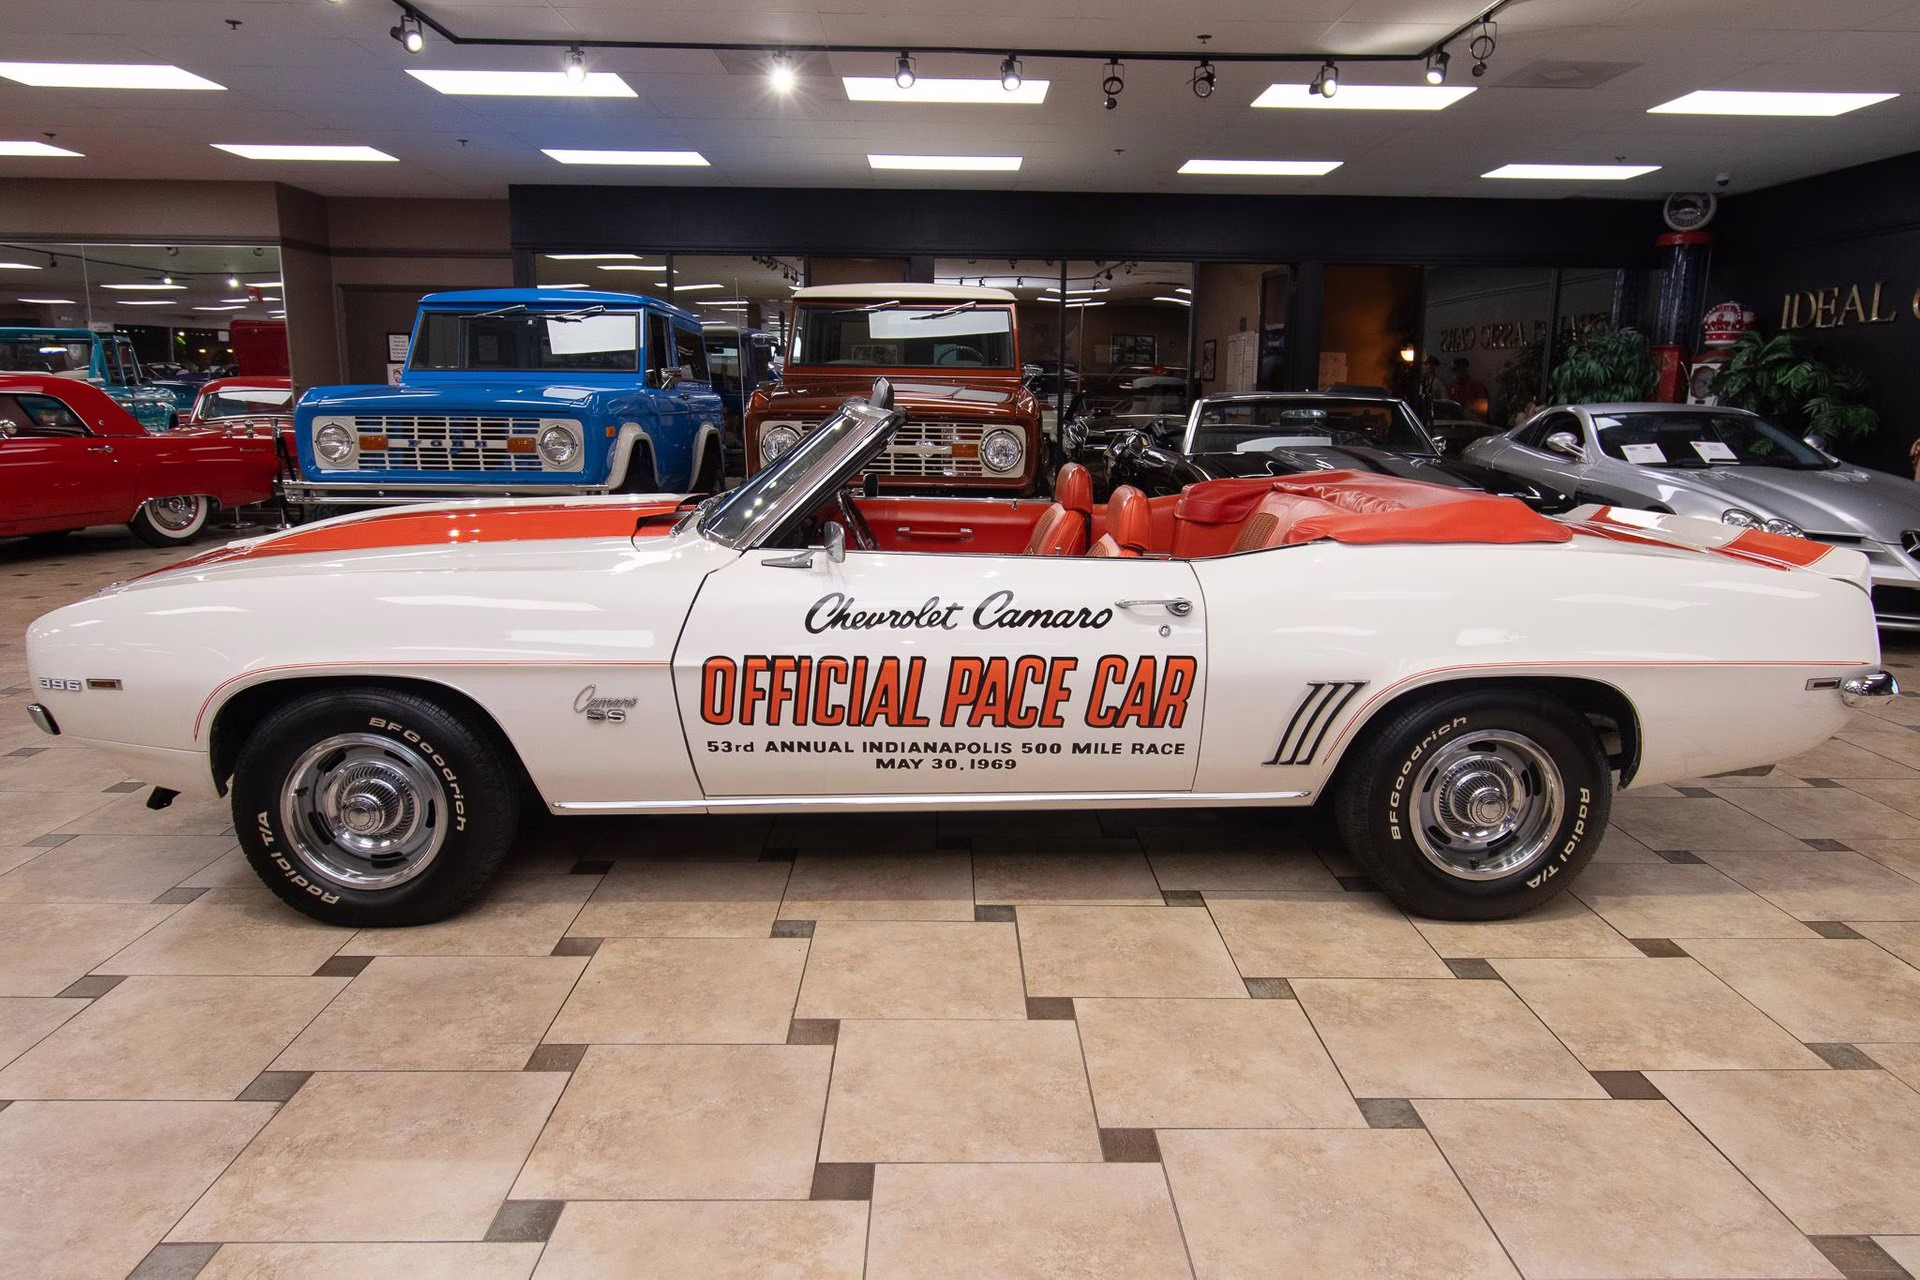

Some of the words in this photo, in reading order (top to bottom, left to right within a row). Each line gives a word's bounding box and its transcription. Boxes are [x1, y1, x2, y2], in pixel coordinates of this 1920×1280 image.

[1780, 282, 1897, 330] IDEAL
[805, 592, 964, 634] Chevrolet
[972, 590, 1113, 630] Camaro
[39, 677, 83, 692] 396
[574, 684, 638, 713] Camaro
[700, 654, 931, 728] OFFICIAL
[940, 654, 1079, 729] PACE
[1084, 654, 1198, 729] CAR
[586, 708, 627, 723] SS
[706, 741, 755, 753] 53rd
[765, 741, 855, 753] ANNUAL
[862, 741, 1013, 754] INDIANAPOLIS
[1021, 742, 1062, 754] 500
[1071, 742, 1122, 754] MILE
[1130, 743, 1186, 755] RACE
[875, 758, 925, 770] MAY
[369, 717, 467, 832] BFGoodrich
[1389, 716, 1467, 840] BFGoodrich
[257, 811, 275, 847] T/A
[1560, 787, 1591, 863] Radial
[267, 851, 340, 905] Radial
[1526, 865, 1559, 889] T/A
